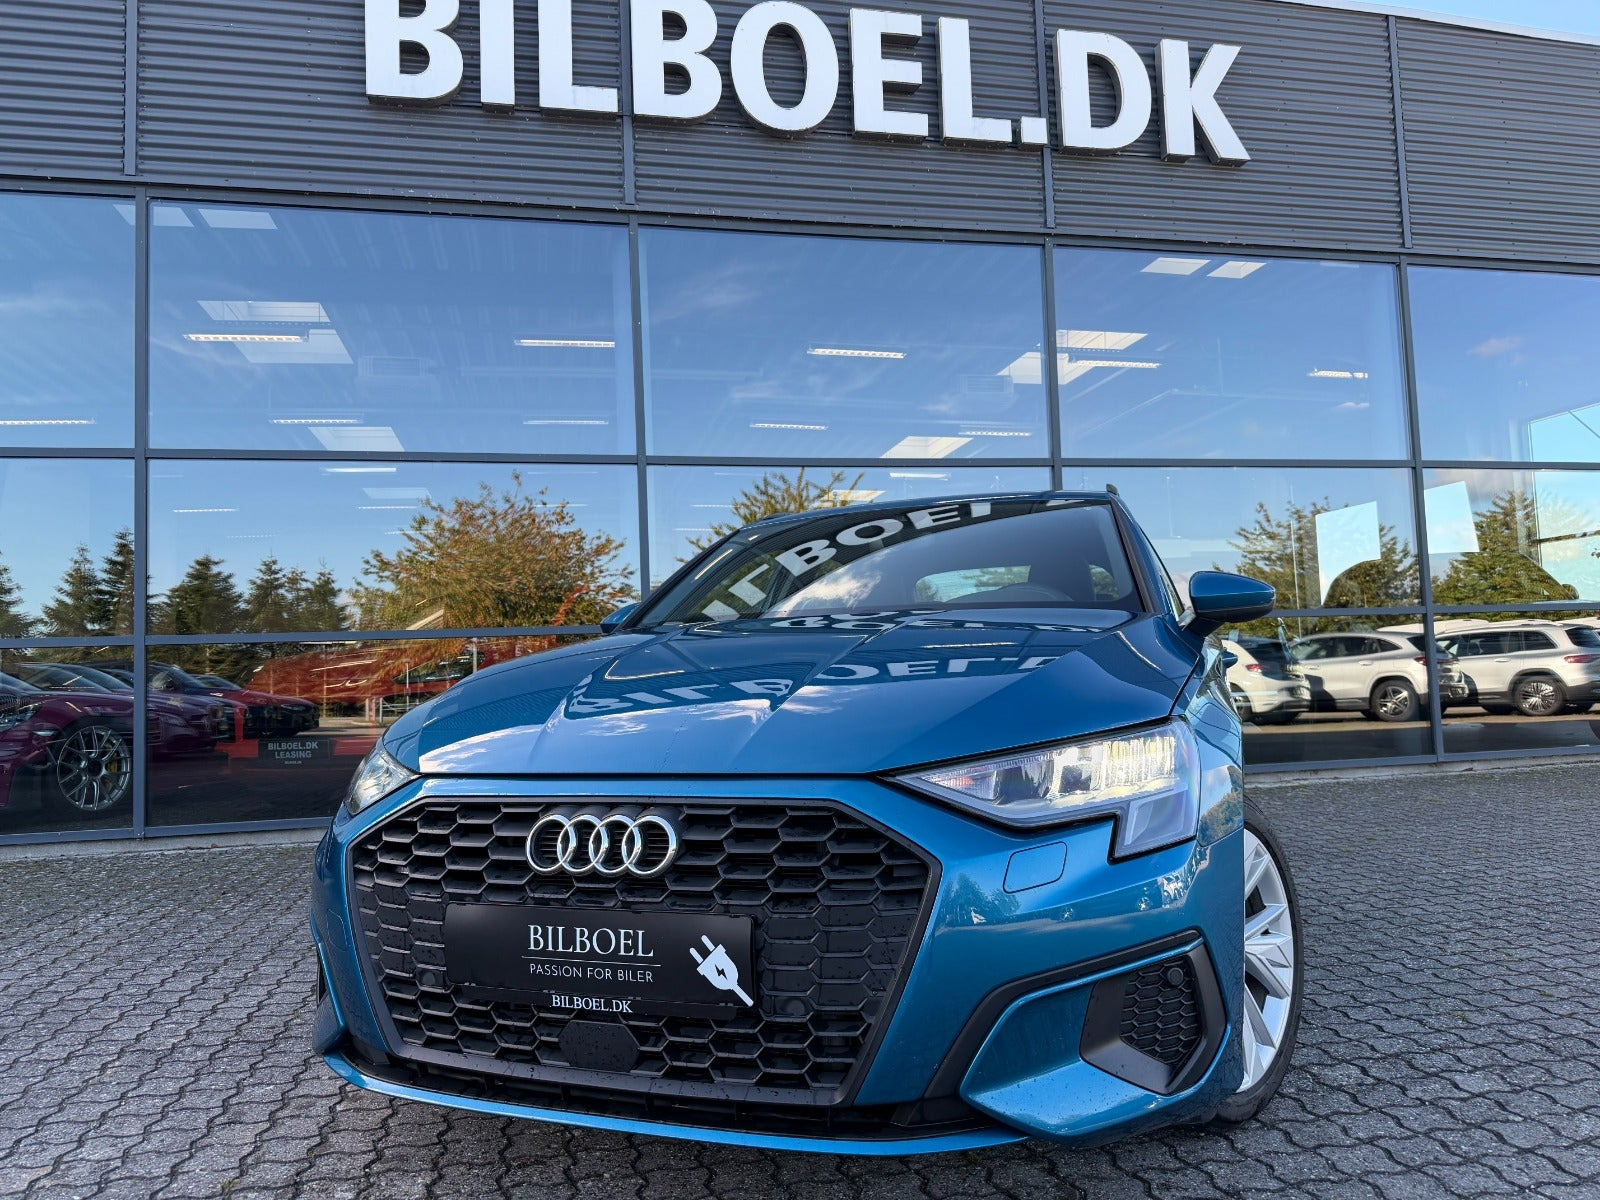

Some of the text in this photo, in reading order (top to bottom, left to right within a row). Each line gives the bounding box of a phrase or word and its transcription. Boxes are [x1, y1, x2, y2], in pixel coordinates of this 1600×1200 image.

[364, 0, 1249, 165] BILBOEL.DK
[268, 741, 318, 750] BILBOEL.DK
[275, 751, 312, 759] LEASING
[527, 924, 654, 957] BILBOEL
[529, 963, 653, 983] PASSION FOR BILER
[551, 994, 632, 1013] BILBOEL.DK
